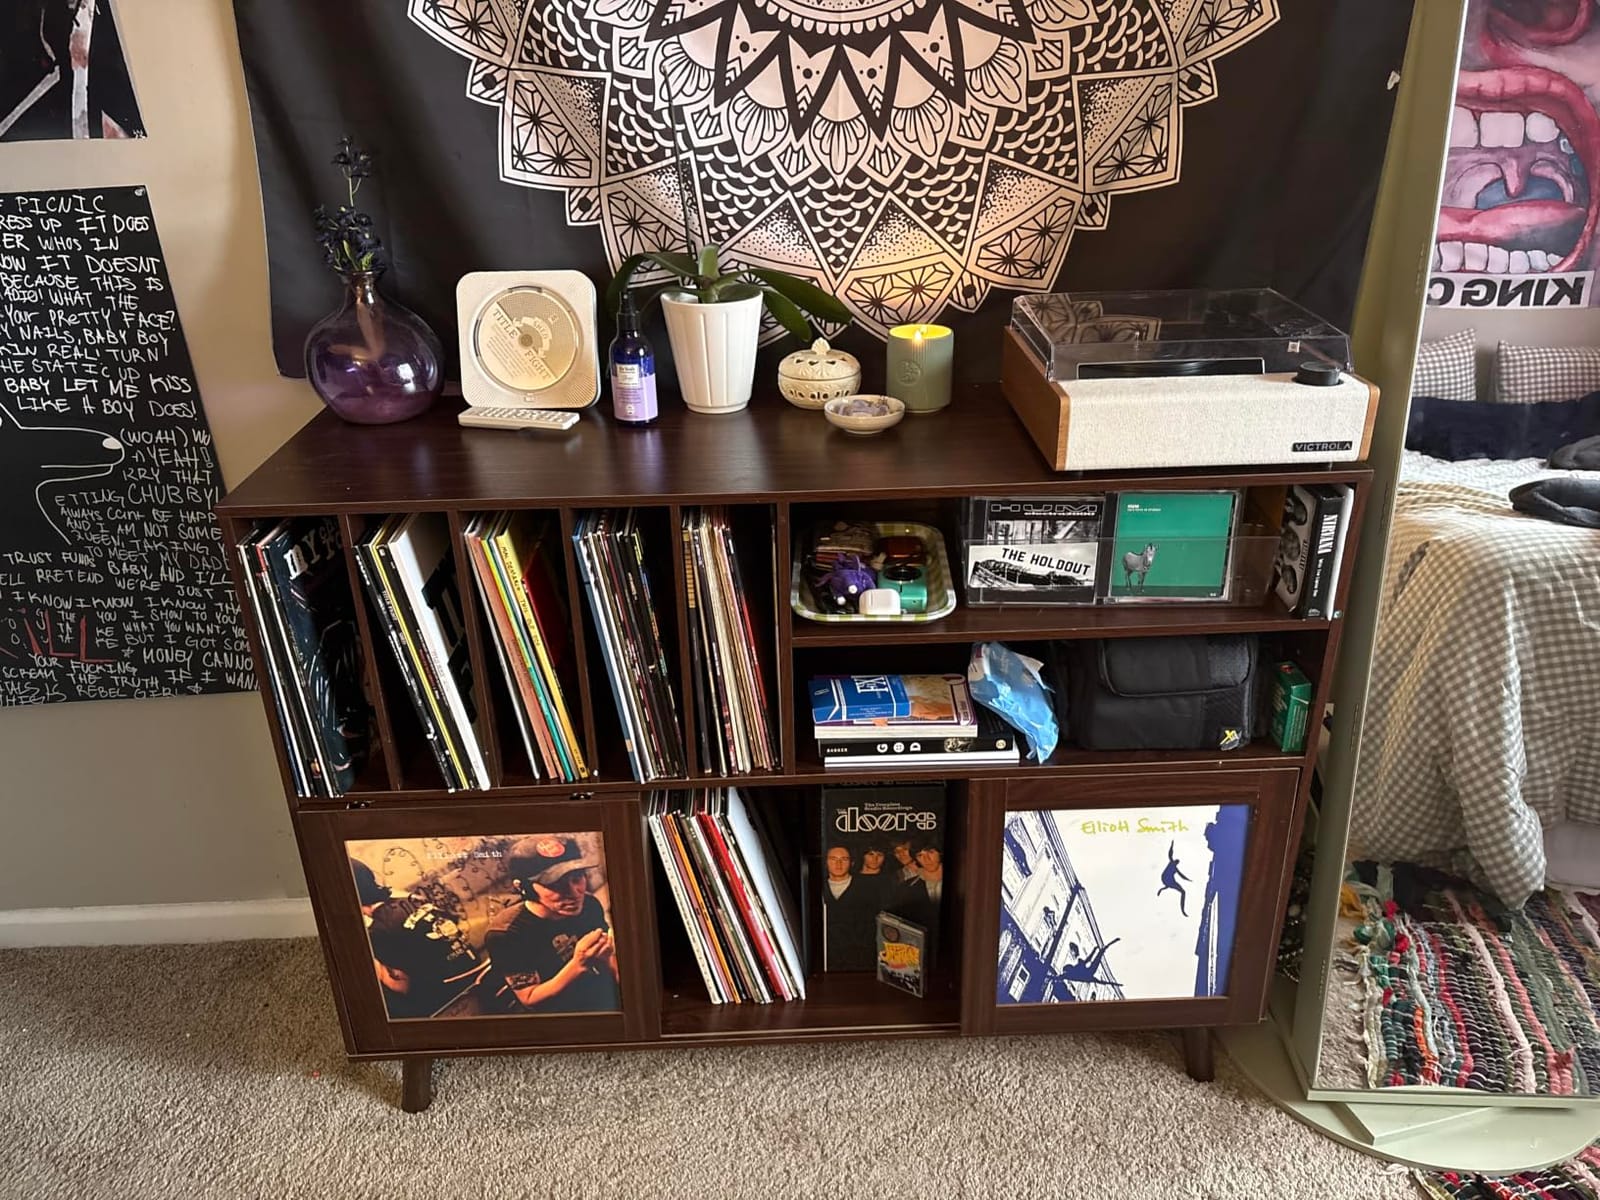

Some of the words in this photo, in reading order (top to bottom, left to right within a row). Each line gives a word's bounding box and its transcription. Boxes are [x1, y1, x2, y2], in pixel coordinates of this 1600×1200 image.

[15, 194, 106, 215] PICNIC
[40, 217, 62, 233] UP
[76, 215, 107, 235] IT
[112, 214, 150, 234] DOES
[37, 235, 82, 251] WHOS
[89, 236, 120, 251] IN
[36, 255, 71, 272] IT
[84, 254, 161, 275] DOESNT
[0, 271, 79, 291] BECAUSE
[90, 276, 137, 292] THIS
[145, 277, 164, 292] IS
[50, 291, 93, 308] WHAT
[104, 294, 139, 311] THE
[122, 310, 176, 333] FACE?
[493, 309, 518, 338] TITLE
[83, 328, 127, 346] BABY
[137, 329, 169, 357] BOY
[105, 349, 159, 363] TURN
[525, 350, 552, 379] FIGHT
[118, 367, 141, 384] UP
[4, 376, 51, 396] BABY
[63, 377, 99, 393] LET
[110, 379, 141, 399] ME
[16, 395, 71, 413] LIKE
[103, 398, 135, 422] BOY
[149, 399, 198, 420] DOES!
[1295, 443, 1351, 451] VICTROLA
[170, 469, 212, 485] THAT
[117, 522, 137, 537] AM
[144, 521, 169, 538] NOT
[178, 523, 223, 541] SOME
[108, 547, 150, 563] MEET
[159, 551, 181, 569] MY
[129, 540, 209, 556] TAKING
[3, 551, 52, 565] TRUST
[160, 563, 185, 583] AND
[1002, 548, 1027, 562] THE
[1030, 554, 1091, 576] HOLDOUT
[115, 577, 161, 592] WE'RE
[176, 584, 214, 600] JUST
[28, 591, 73, 610] KNOW
[96, 611, 117, 624] YOU
[122, 621, 156, 633] WHAT
[164, 621, 181, 633] YOU
[27, 652, 64, 668] YOUR
[143, 647, 193, 671] MONEY
[224, 672, 260, 691] WAN
[835, 806, 937, 833] doors
